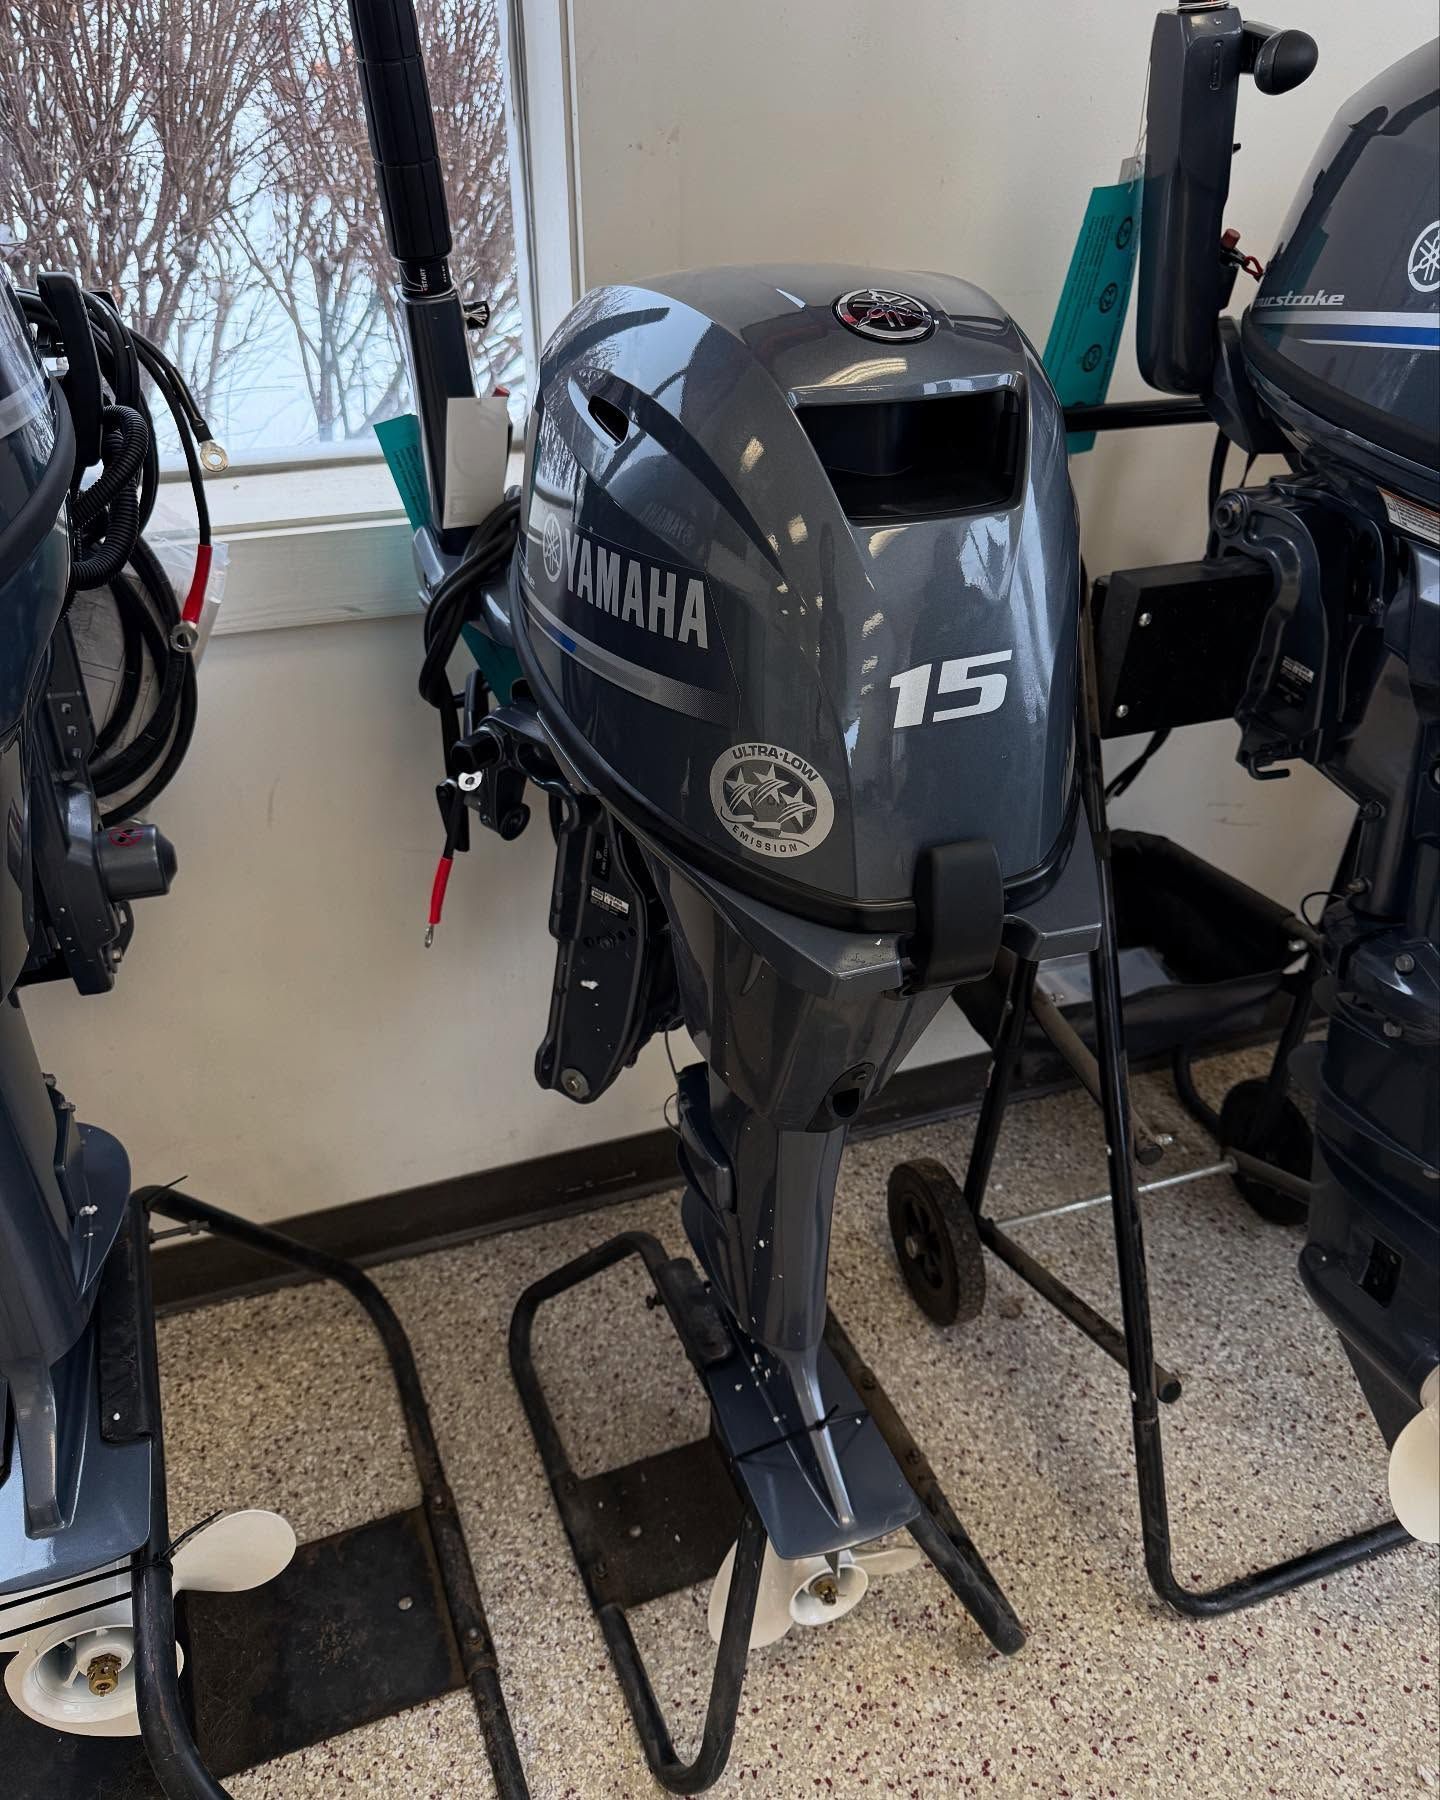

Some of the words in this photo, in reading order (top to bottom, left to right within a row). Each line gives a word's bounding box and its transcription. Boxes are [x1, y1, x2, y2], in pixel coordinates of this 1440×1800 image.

[565, 528, 708, 649] YAMAHA
[890, 649, 1012, 729] 15
[732, 824, 798, 853] EMISSION
